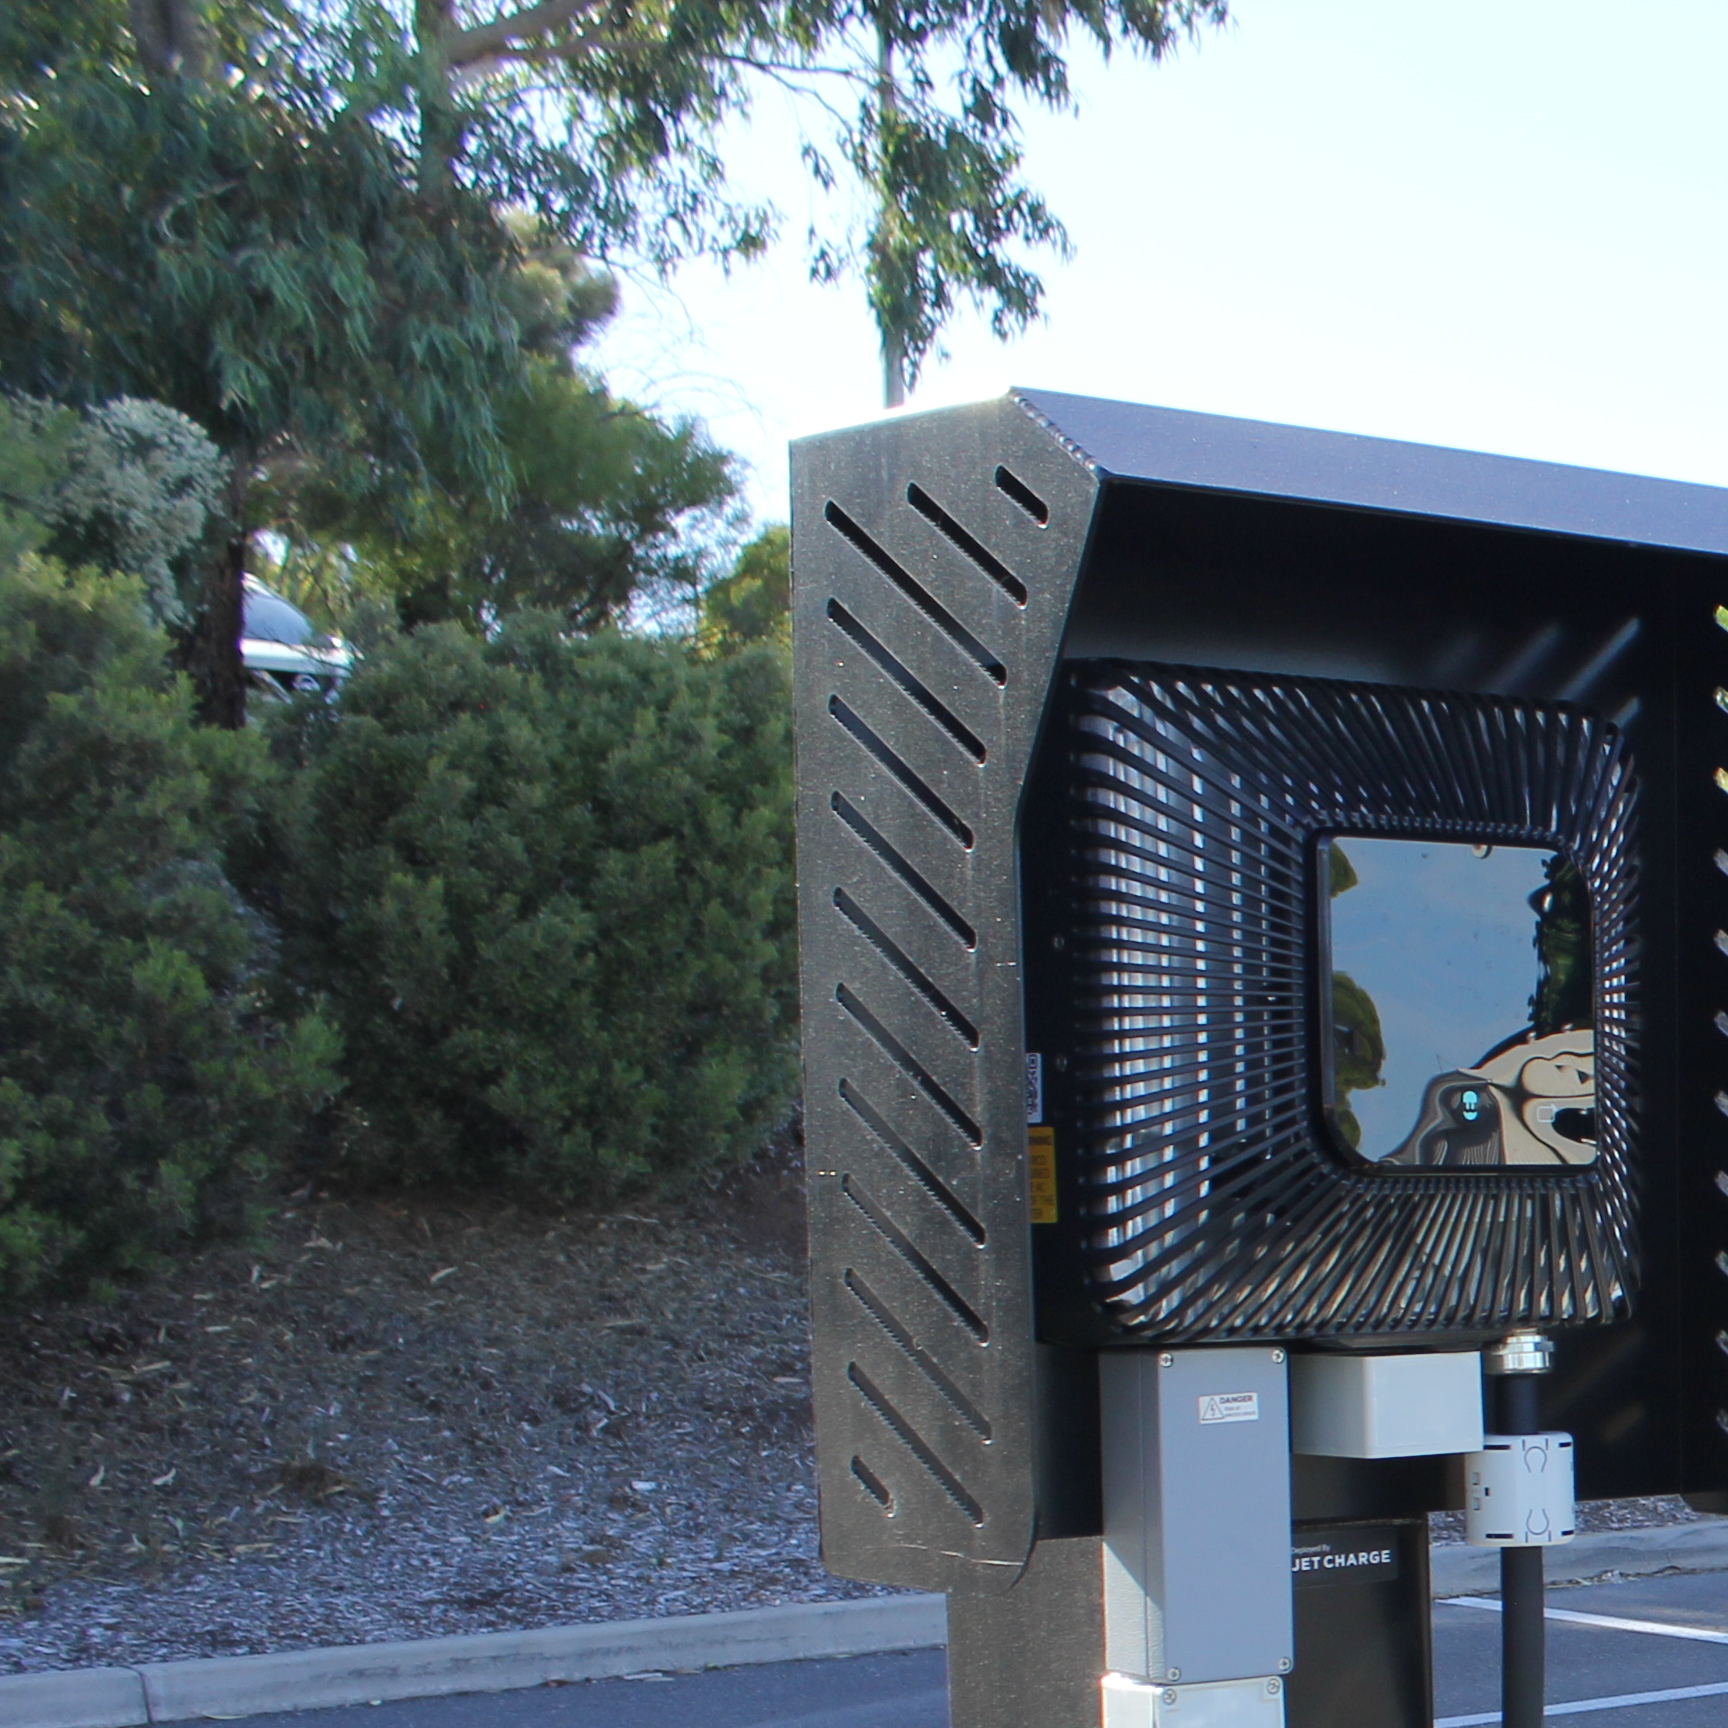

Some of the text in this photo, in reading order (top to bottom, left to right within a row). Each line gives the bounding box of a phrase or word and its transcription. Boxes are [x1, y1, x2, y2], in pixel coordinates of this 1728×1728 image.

[1219, 1394, 1253, 1405] DANGER
[1291, 1550, 1391, 1572] JET CHARGE
